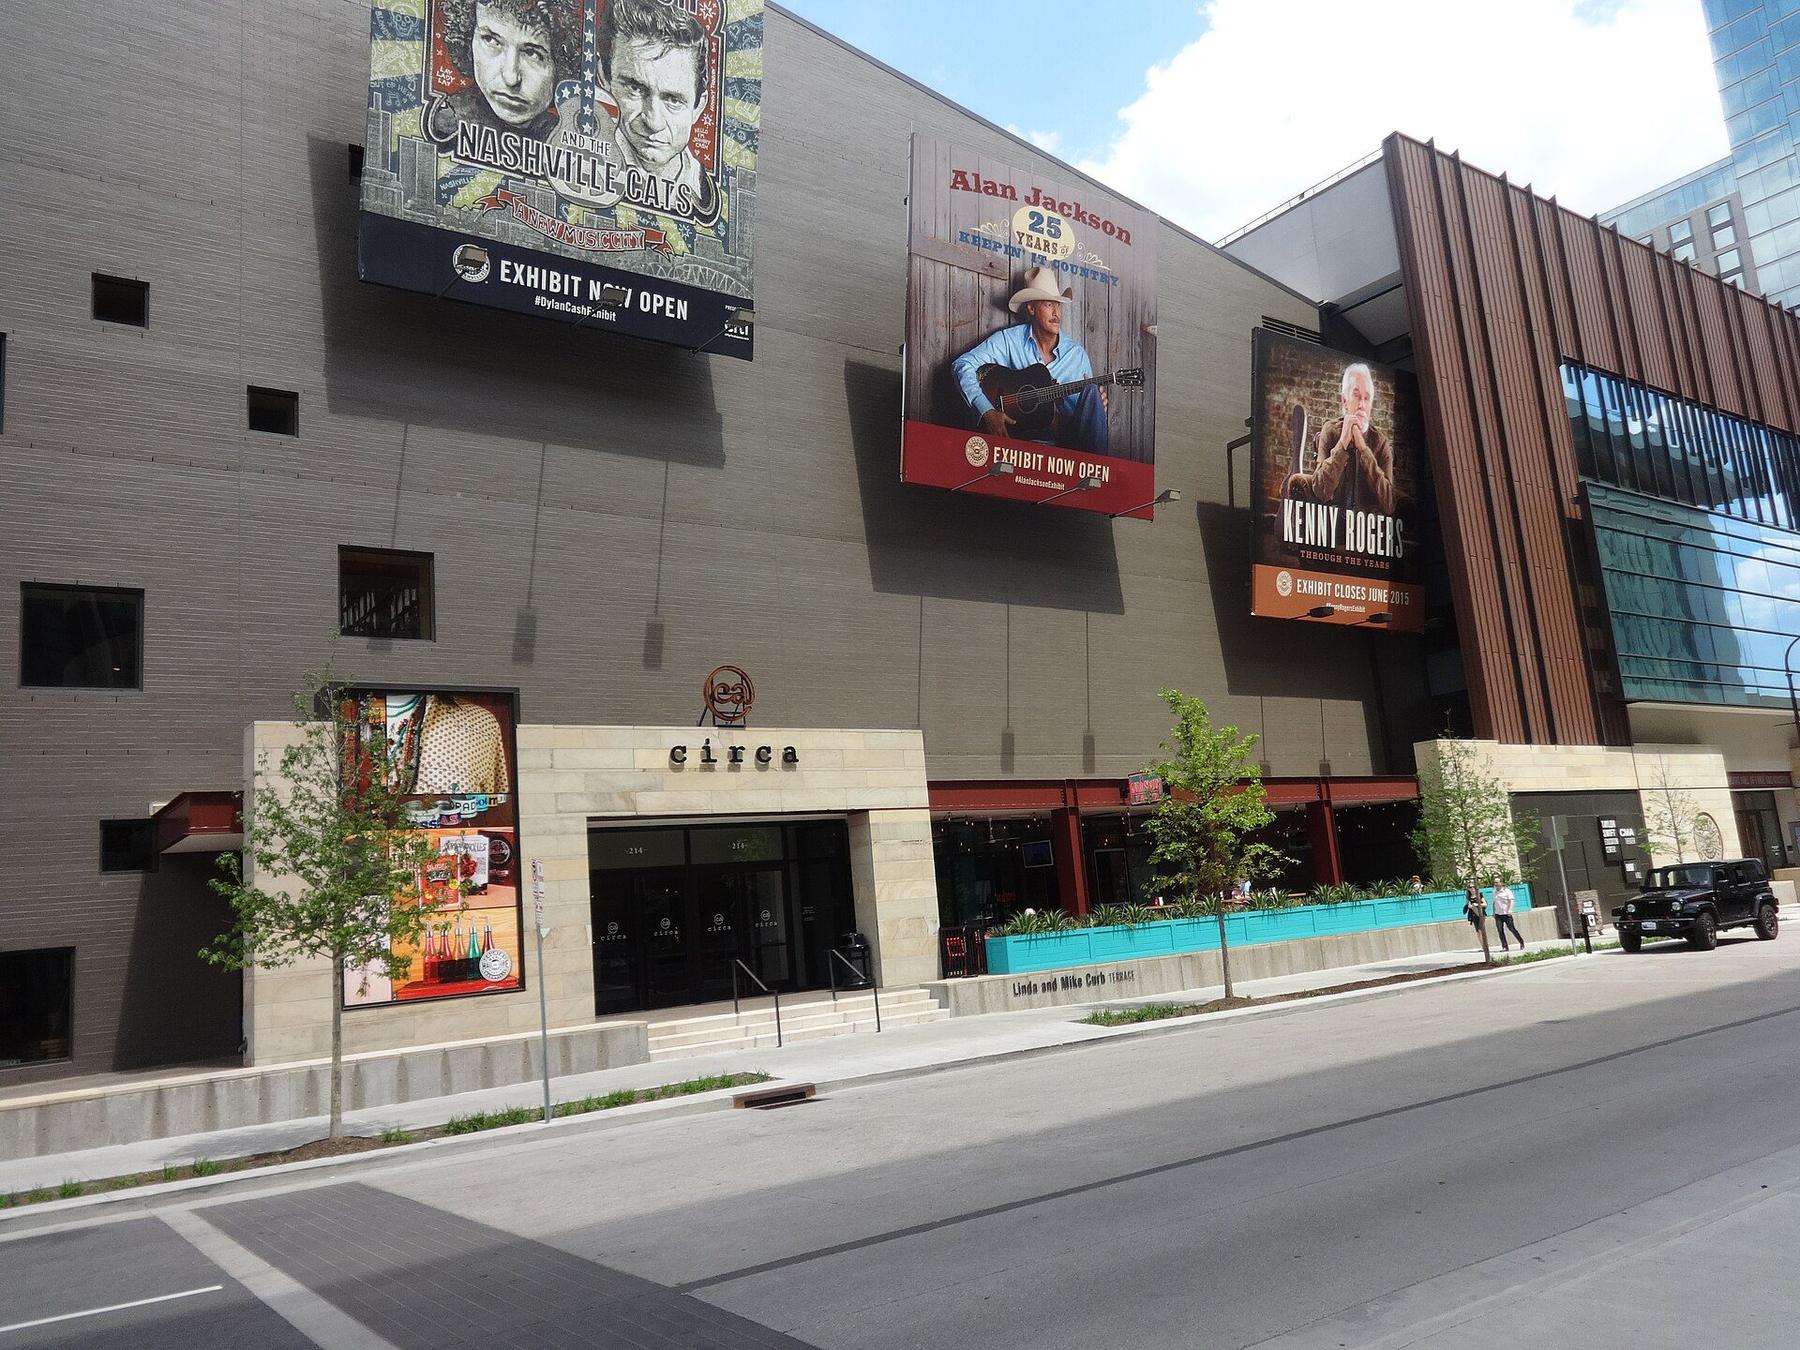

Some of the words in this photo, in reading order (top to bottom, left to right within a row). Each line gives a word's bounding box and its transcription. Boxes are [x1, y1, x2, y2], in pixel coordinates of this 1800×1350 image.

[561, 130, 585, 148] AND
[589, 136, 611, 157] THE
[458, 120, 619, 194] NASHVILLE
[625, 164, 693, 216] CATS
[950, 169, 1018, 201] Alan
[1024, 187, 1132, 246] Jackson
[528, 210, 560, 238] NEW
[563, 228, 609, 249] MUSIC
[610, 231, 644, 249] CITY
[1028, 211, 1062, 240] 25
[1016, 231, 1058, 255] YEARS
[958, 230, 1025, 259] KEEPIN'
[1030, 252, 1048, 266] IT
[1051, 259, 1119, 287] COUNTRY
[500, 260, 582, 297] EXHIBIT
[589, 280, 632, 309] NW
[640, 291, 688, 321] OPEN
[993, 446, 1043, 472] EXHIBIT
[1047, 456, 1075, 477] NOW
[1079, 462, 1110, 483] OPEN
[1015, 475, 1065, 491] #AlanJacksonExhibit
[1283, 499, 1338, 549] KENNY
[1345, 509, 1403, 559] ROGERS
[1300, 550, 1342, 564] THROUGH
[1345, 556, 1361, 566] THE
[1364, 559, 1390, 570] YEARS
[1296, 579, 1332, 597] EXHIBIT
[1334, 583, 1366, 600] CLOSES
[1368, 587, 1388, 603] JUNE
[1390, 590, 1409, 605] 2015
[670, 738, 799, 763] circa
[1013, 981, 1038, 997] Linda
[1041, 977, 1057, 993] and
[1060, 975, 1083, 991] Mike
[1086, 971, 1105, 988] Curb
[1109, 969, 1135, 983] TERRACE
